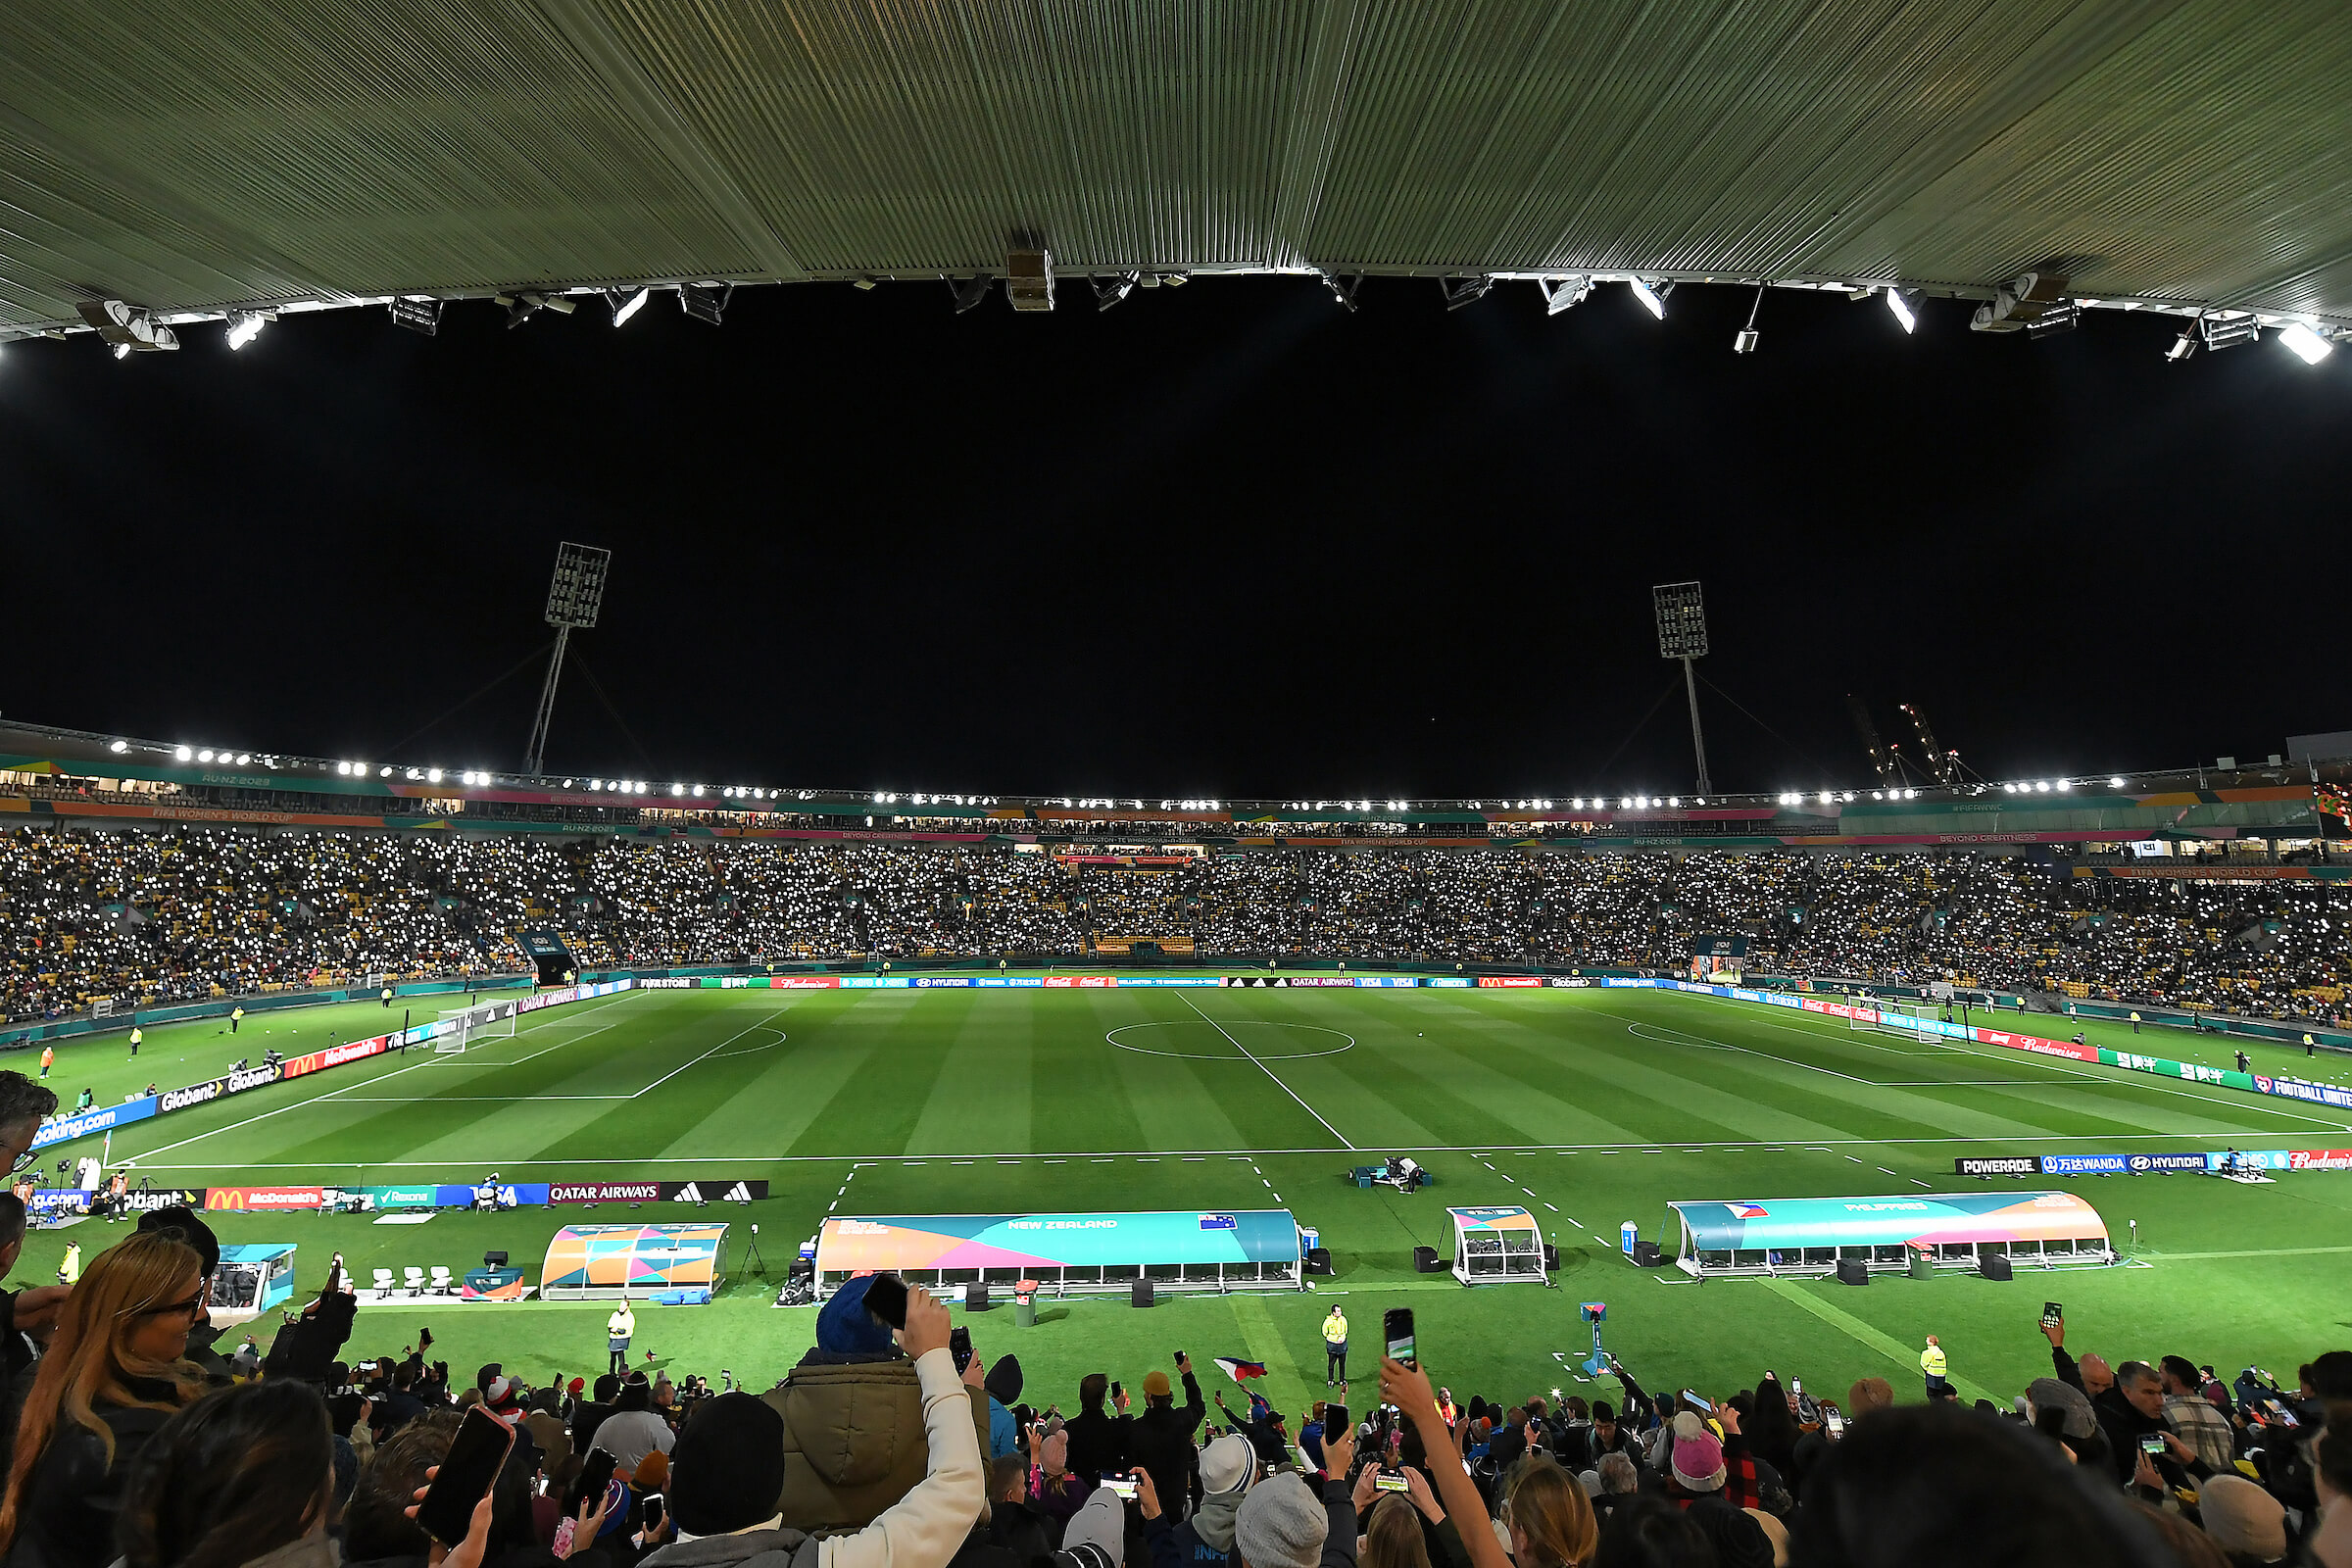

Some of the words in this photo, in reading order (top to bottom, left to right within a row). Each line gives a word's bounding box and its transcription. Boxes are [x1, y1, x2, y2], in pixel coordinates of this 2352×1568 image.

[152, 808, 175, 817] FIFA
[177, 808, 228, 820] WOMEN'S
[231, 811, 270, 821] WORLD
[271, 813, 294, 822] CUP
[1980, 833, 2037, 842] GREATNESS
[2131, 868, 2153, 877] FIFA
[2155, 868, 2207, 877] WOMEN'S
[2209, 868, 2251, 877] WORLD
[2254, 868, 2278, 877] CUP
[662, 978, 690, 988] STORE
[781, 978, 830, 988] Budweiser
[932, 978, 969, 987] HYUNDAI
[1046, 977, 1072, 987] Coca-Cola
[1080, 977, 1106, 987] Coca-Cola
[1293, 978, 1318, 987] QATAR
[1321, 978, 1354, 987] AIRWAYS
[1359, 977, 1382, 988] VISA
[1392, 977, 1414, 988] VISA
[1503, 978, 1540, 987] McDonald's
[1551, 978, 1585, 988] Globant
[1609, 978, 1655, 988] Booking.com
[521, 997, 545, 1012] QATAR
[545, 988, 575, 1007] AIRWAYS
[323, 1039, 377, 1066] McDonald's
[2020, 1037, 2082, 1060] Budweiser
[227, 1066, 275, 1094] Globant
[2274, 1080, 2324, 1102] FOOTBALL
[161, 1082, 217, 1113] Globant
[32, 1108, 117, 1146] ooking.com
[1963, 1159, 2035, 1173] POWERADE
[2152, 1156, 2204, 1168] HYUNDAI
[248, 1192, 318, 1204] McDonald's
[391, 1191, 427, 1201] Rexona
[550, 1186, 600, 1201] QATAR
[600, 1184, 658, 1200] AIRWAYS
[1843, 1201, 1929, 1212] PHILIPPINES
[1007, 1221, 1043, 1230] NEW
[1045, 1220, 1118, 1230] ZEALAND
